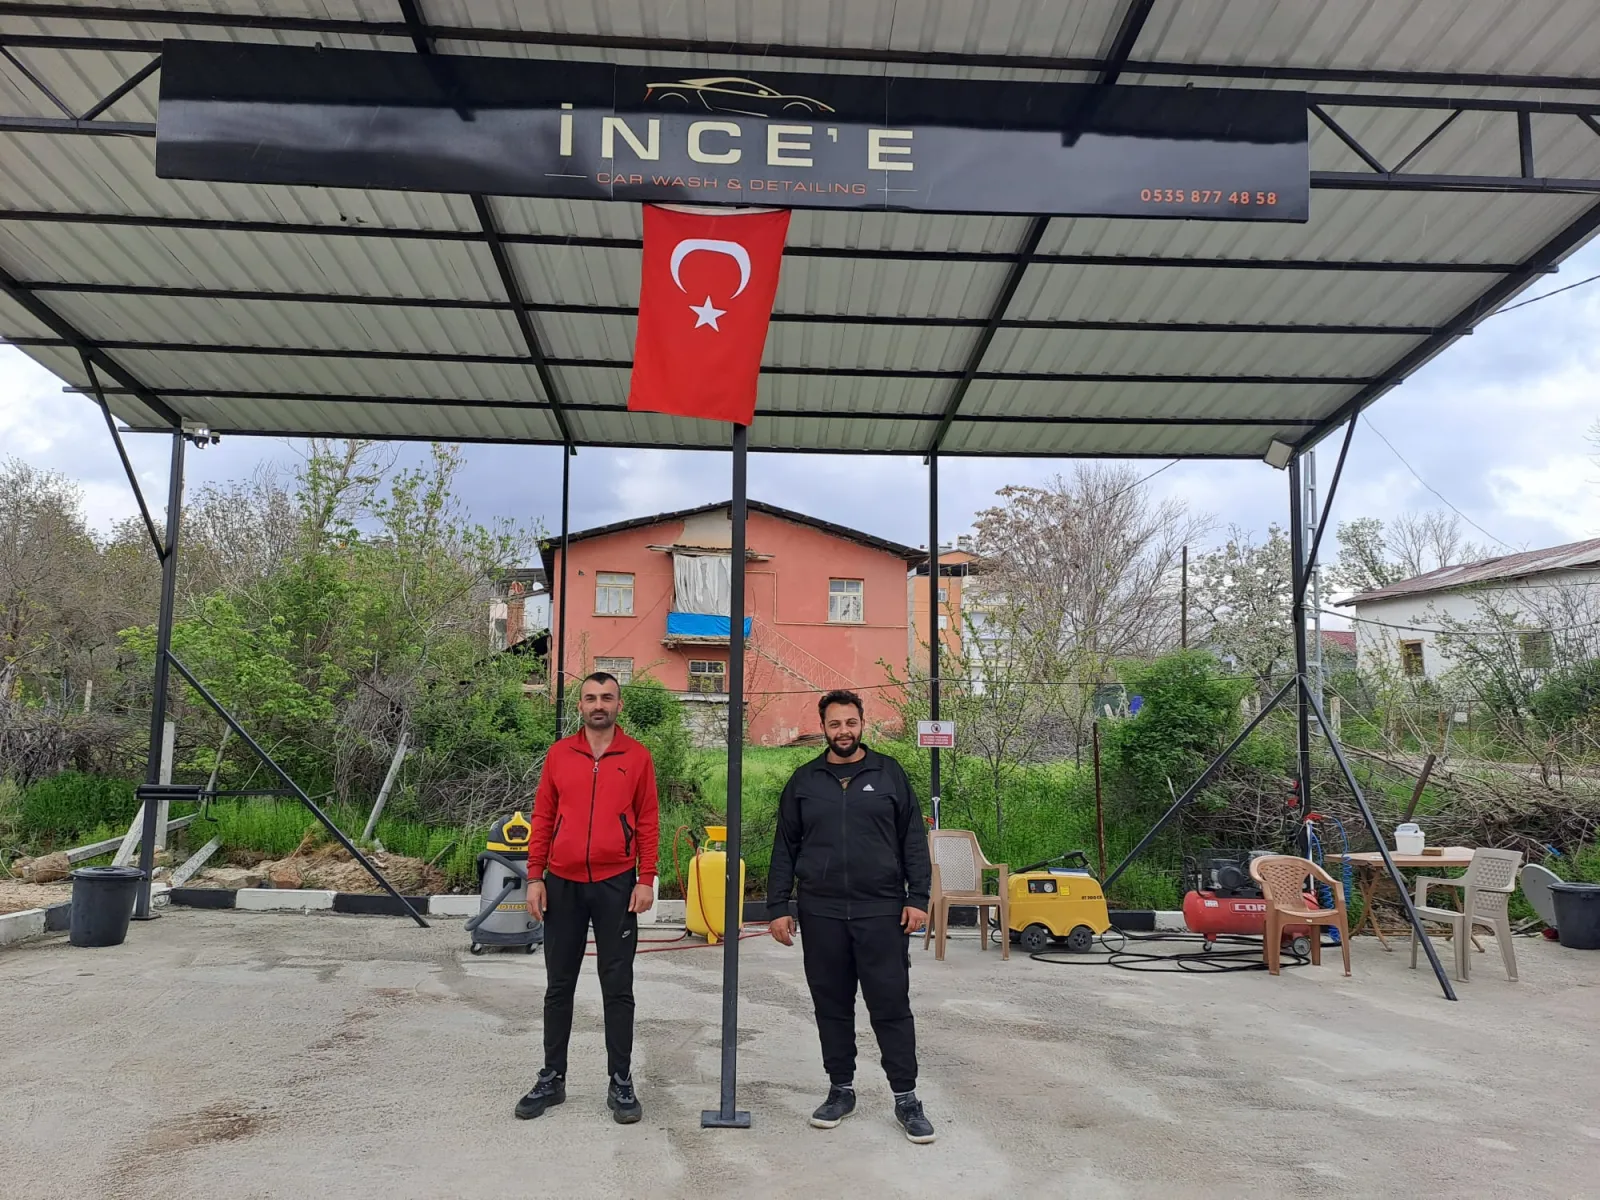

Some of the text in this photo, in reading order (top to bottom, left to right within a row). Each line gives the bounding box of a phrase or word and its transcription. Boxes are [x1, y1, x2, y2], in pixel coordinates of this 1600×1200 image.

[596, 172, 867, 195] CAR WASH & DETAILING
[1140, 188, 1277, 205] 0535 877 48 58
